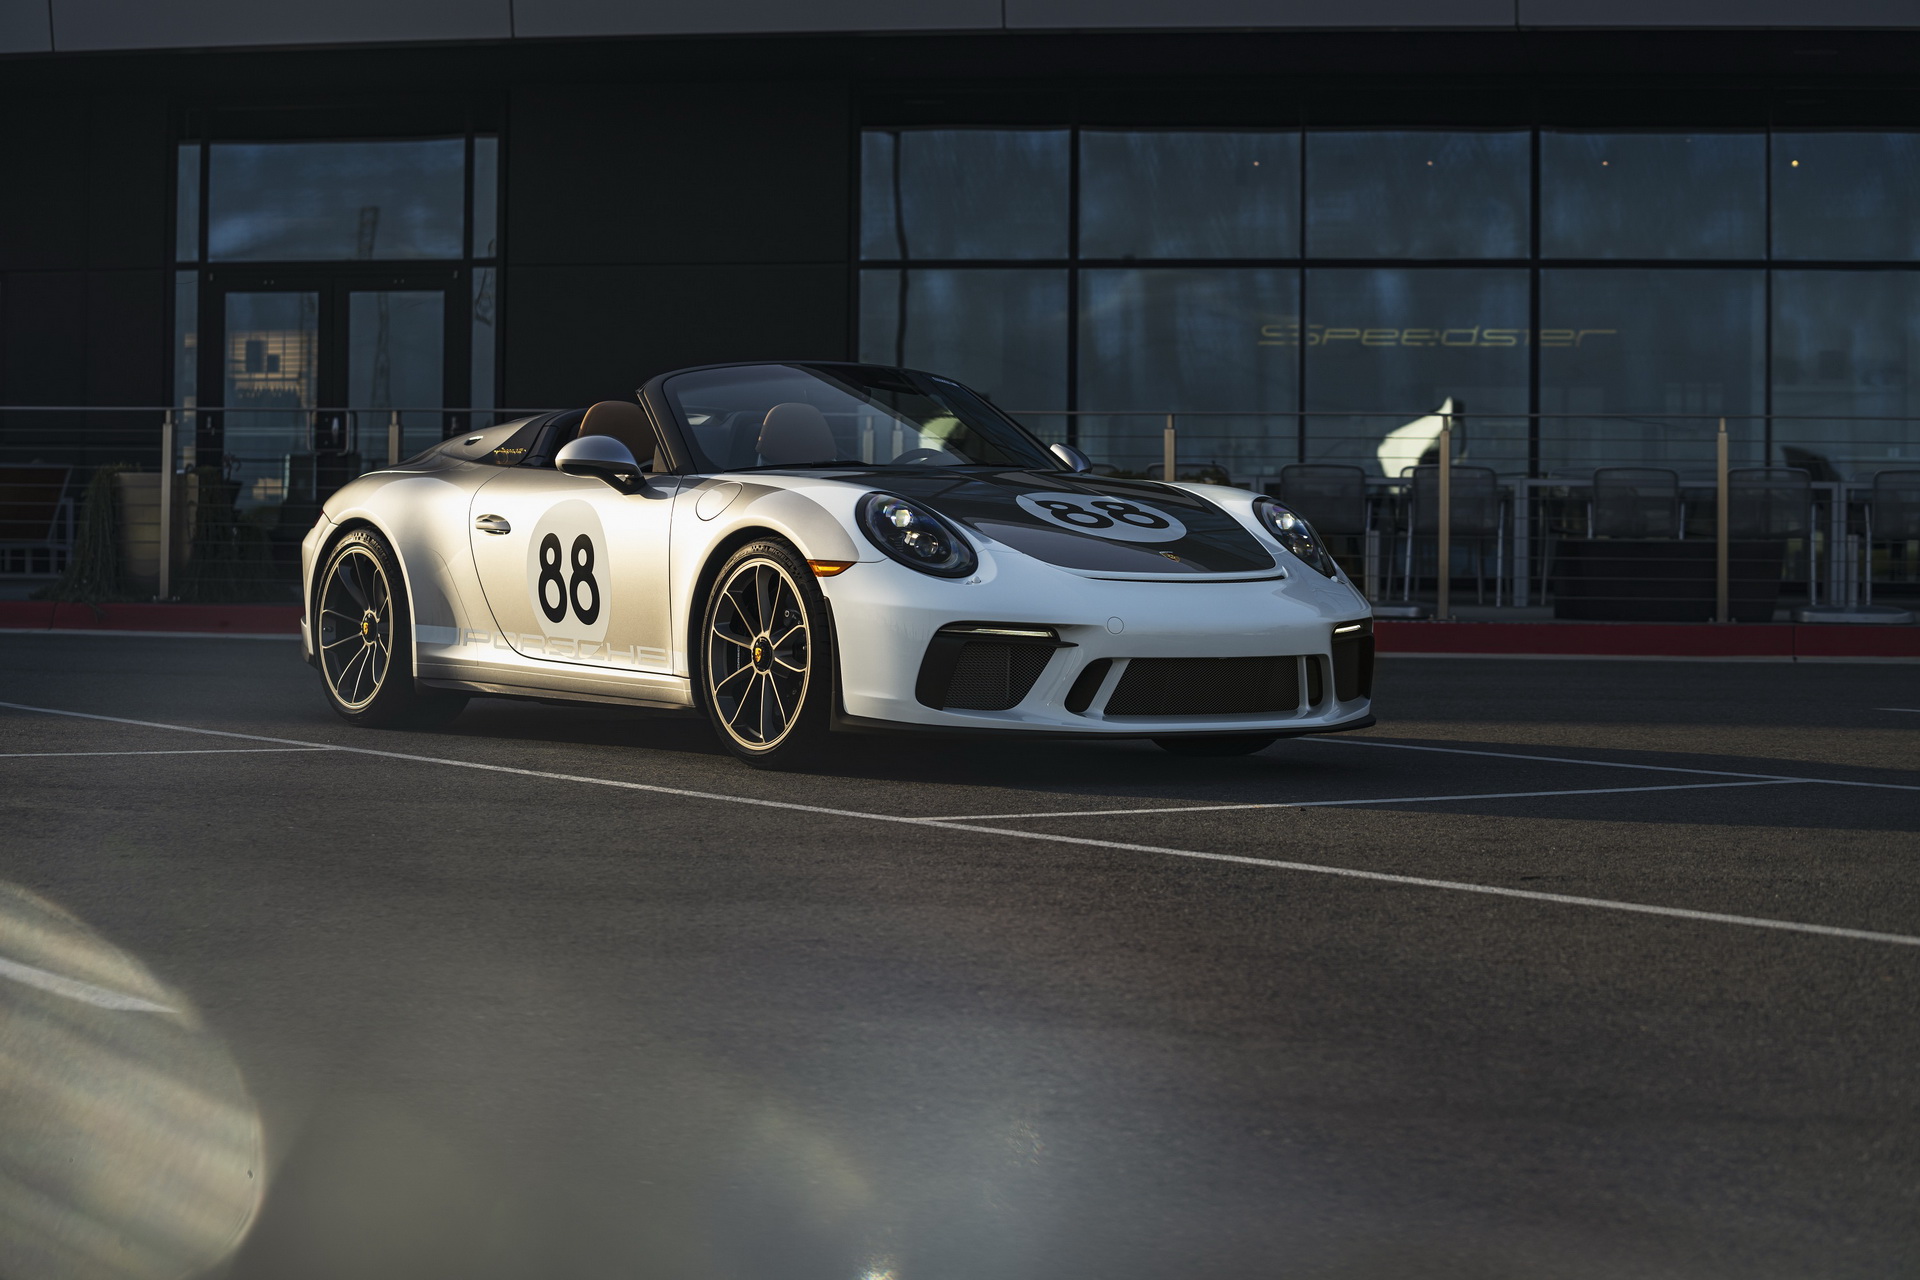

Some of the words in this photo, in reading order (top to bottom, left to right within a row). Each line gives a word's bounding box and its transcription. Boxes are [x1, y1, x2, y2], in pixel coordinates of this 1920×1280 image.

[1034, 500, 1170, 529] 88
[538, 532, 601, 626] 88
[463, 629, 668, 668] PORSCHE
